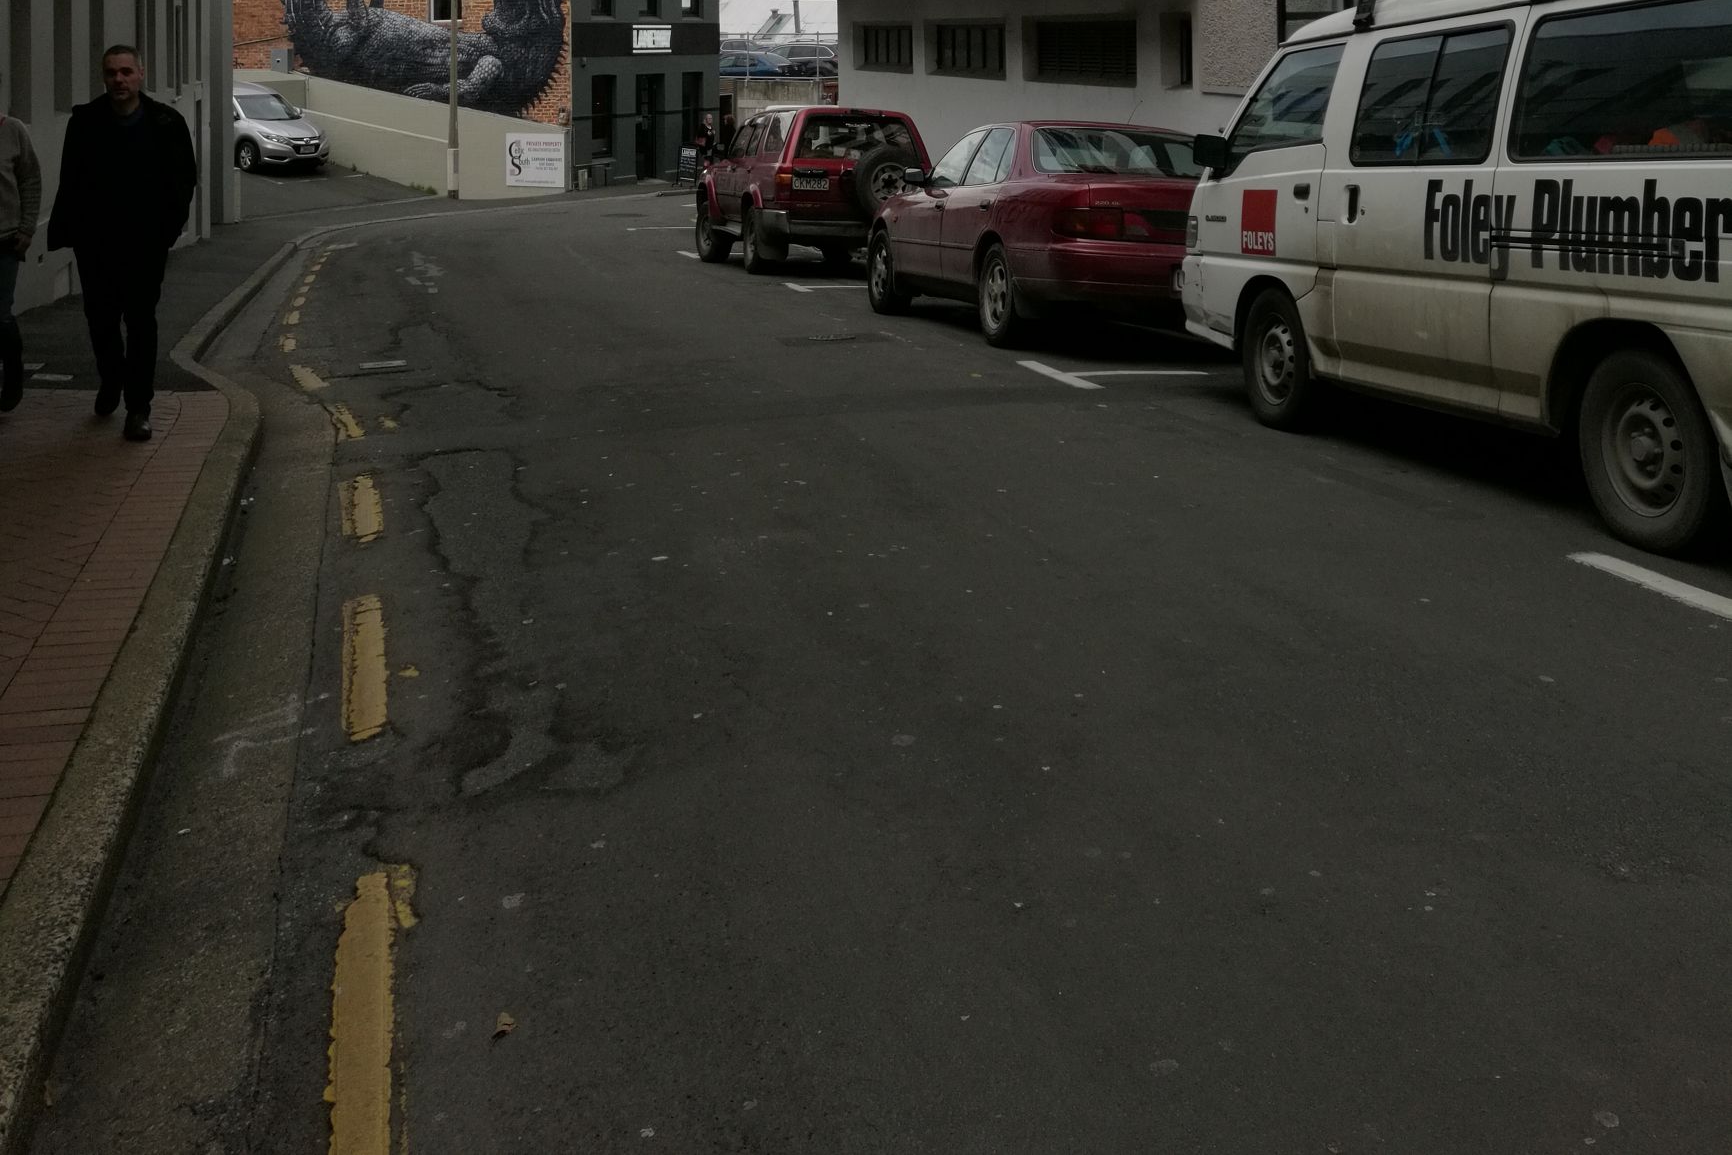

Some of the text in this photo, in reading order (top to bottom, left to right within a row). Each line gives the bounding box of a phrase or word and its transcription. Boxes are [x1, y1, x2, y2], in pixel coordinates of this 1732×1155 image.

[793, 178, 828, 190] CKM282
[1242, 230, 1274, 251] FOLEYS
[1424, 178, 1732, 284] Foley Plumber
